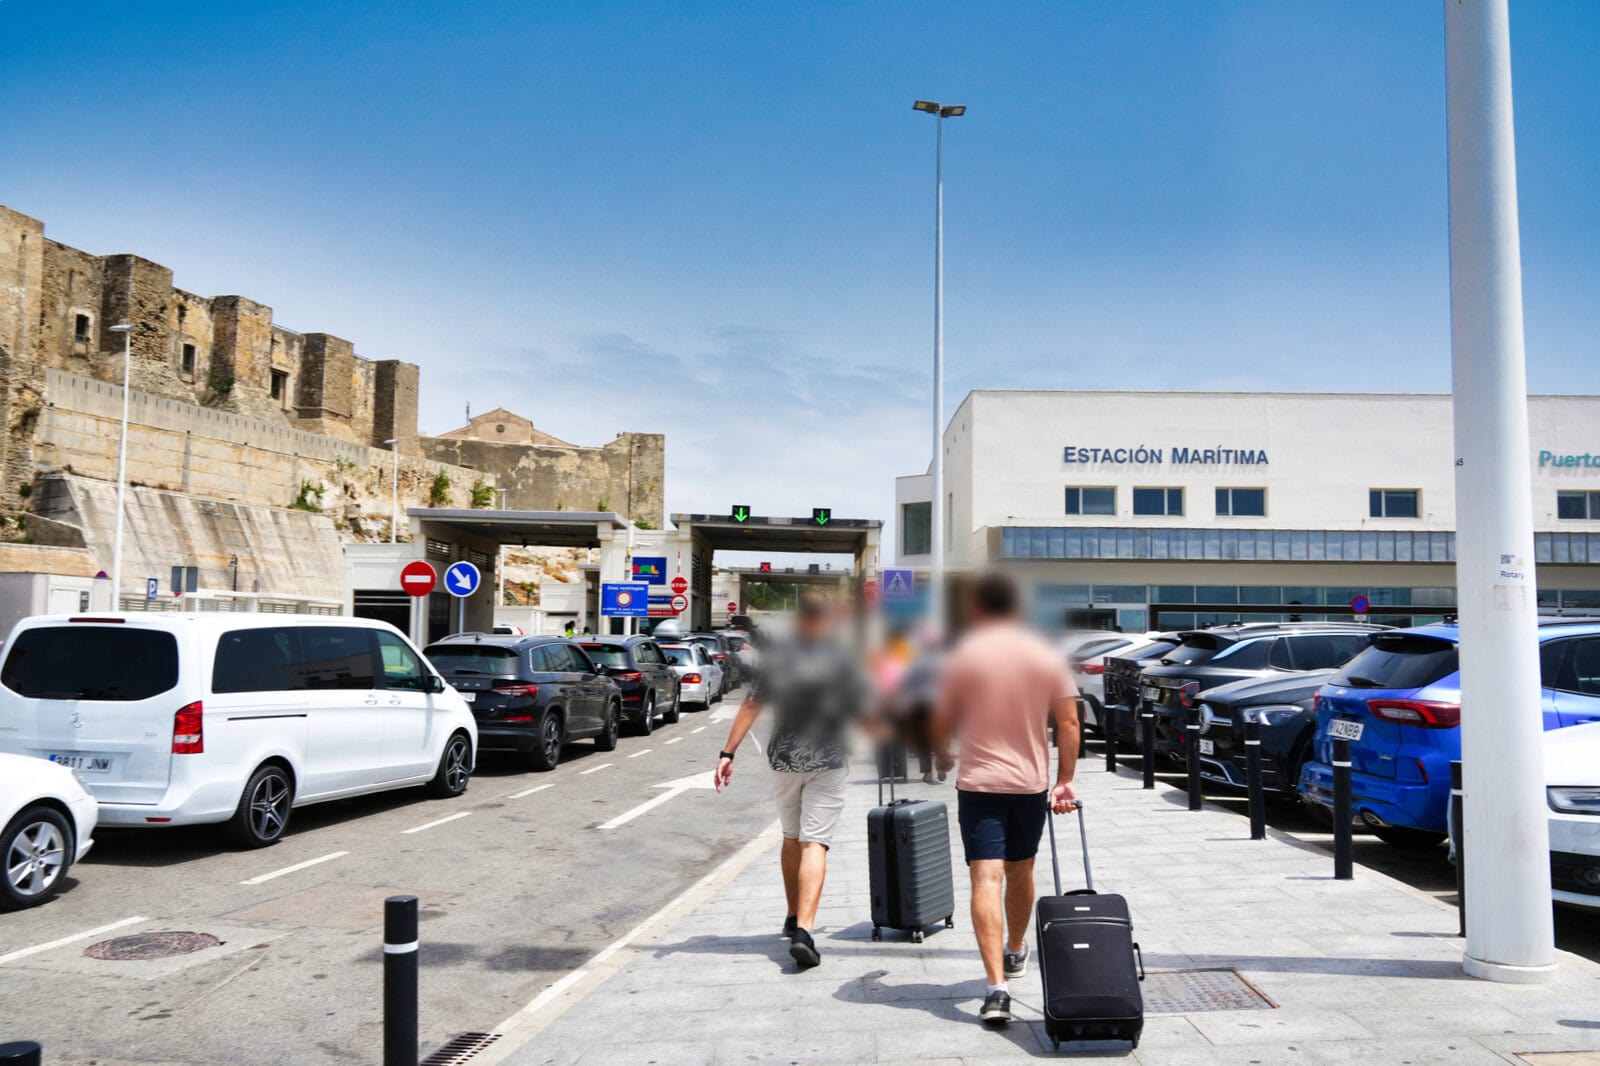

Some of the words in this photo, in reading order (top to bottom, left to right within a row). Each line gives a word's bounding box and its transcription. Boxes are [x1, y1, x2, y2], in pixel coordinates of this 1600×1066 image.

[1063, 445, 1162, 464] ESTACIÓN
[1171, 445, 1269, 465] MARÍTIMA
[1500, 570, 1524, 580] Rotary
[149, 580, 157, 593] P
